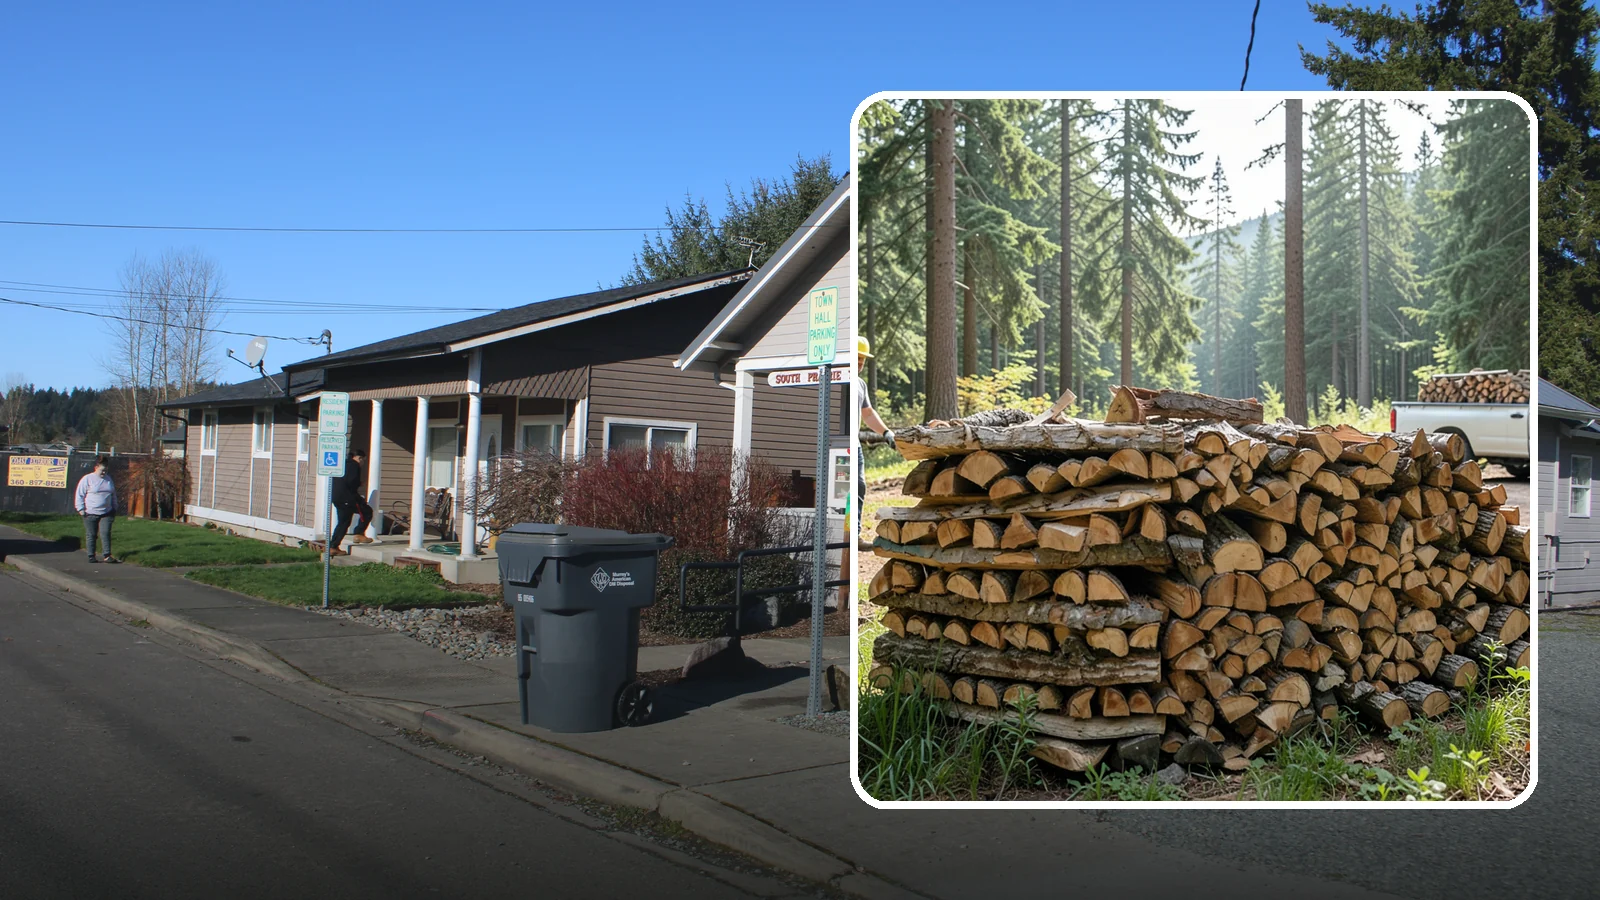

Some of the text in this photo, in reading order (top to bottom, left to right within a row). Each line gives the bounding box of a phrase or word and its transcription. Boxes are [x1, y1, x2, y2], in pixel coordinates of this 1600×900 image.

[815, 295, 833, 307] TOWN
[814, 312, 831, 324] HALL
[810, 327, 836, 340] PARKING
[813, 344, 830, 357] ONLY
[775, 373, 801, 384] SOUTH
[807, 371, 842, 382] PRIE
